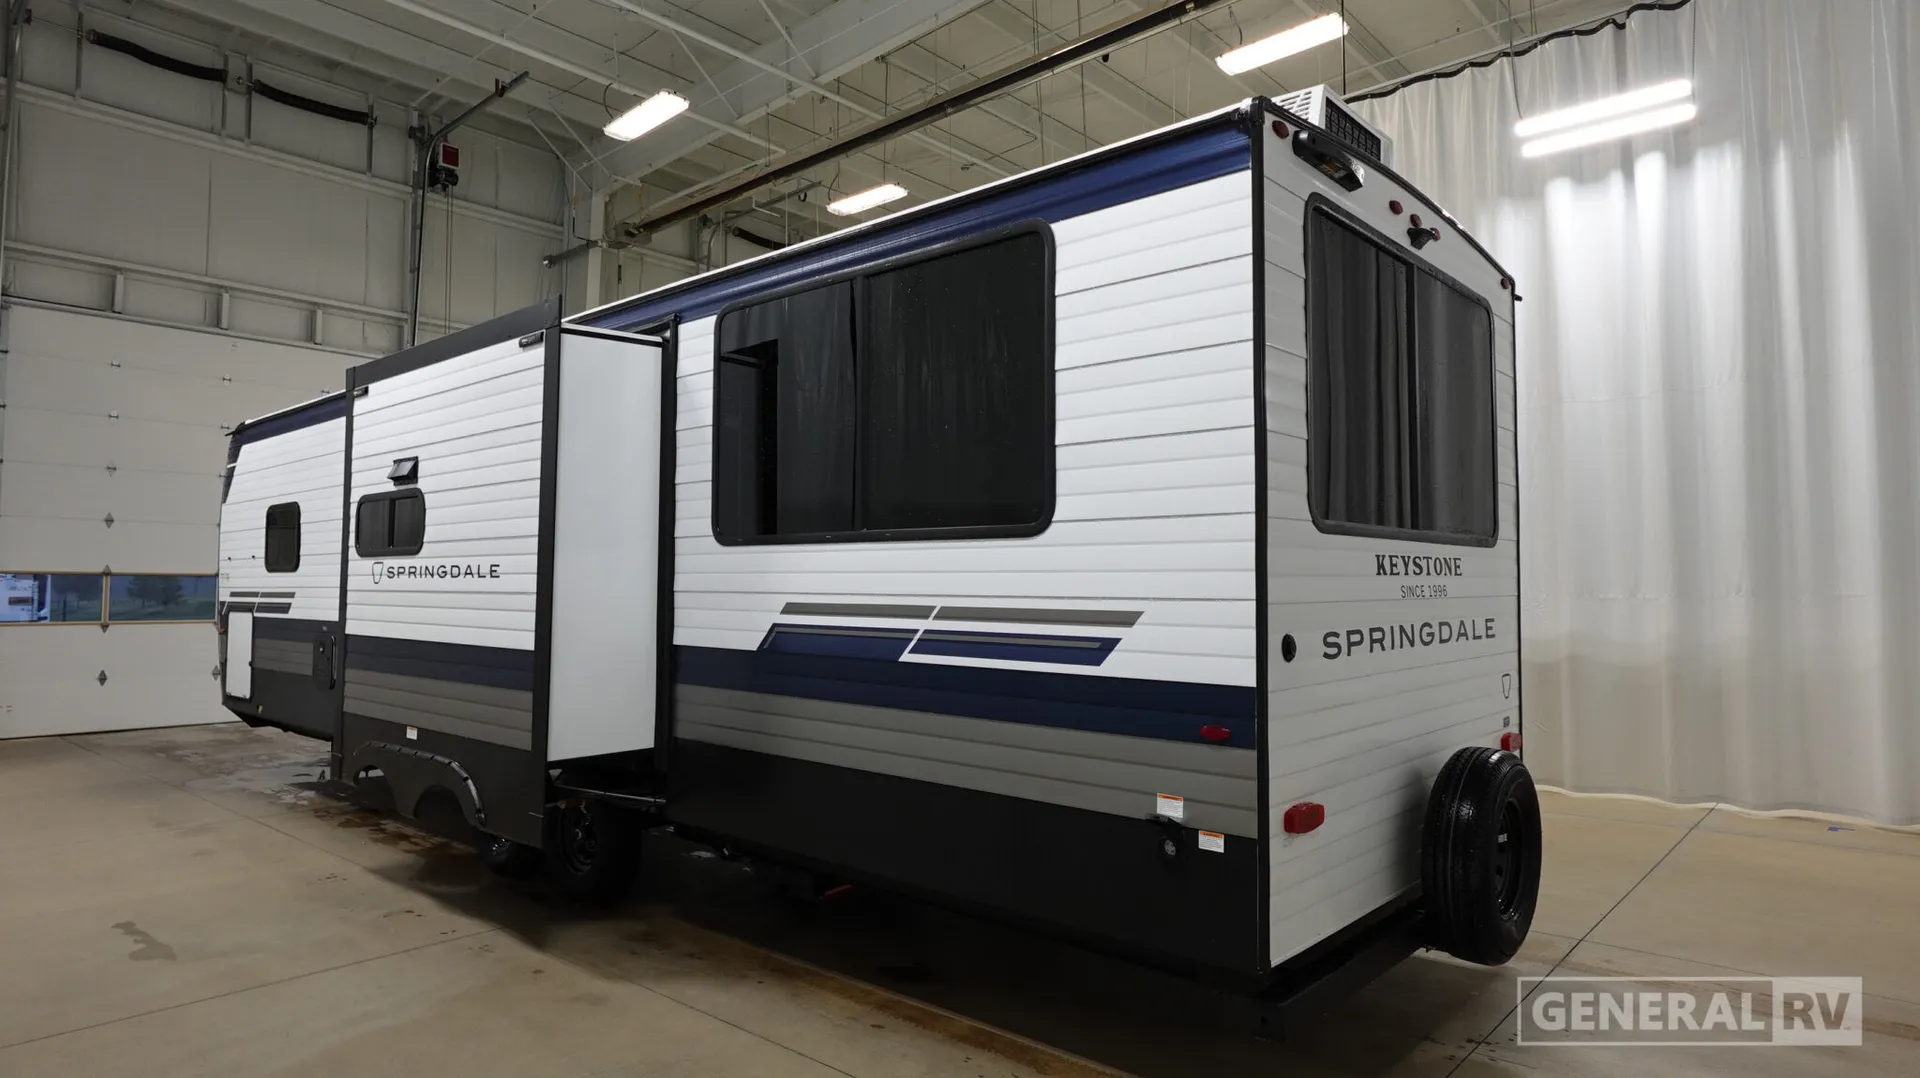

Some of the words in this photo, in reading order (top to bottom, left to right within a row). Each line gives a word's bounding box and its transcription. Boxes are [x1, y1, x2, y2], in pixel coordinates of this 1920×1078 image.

[386, 564, 500, 579] SPRINGDALE
[1375, 555, 1463, 577] KEYSTONE
[1400, 585, 1426, 599] SINCE
[1427, 584, 1448, 598] 1996
[1322, 618, 1496, 660] SPRINGDALE
